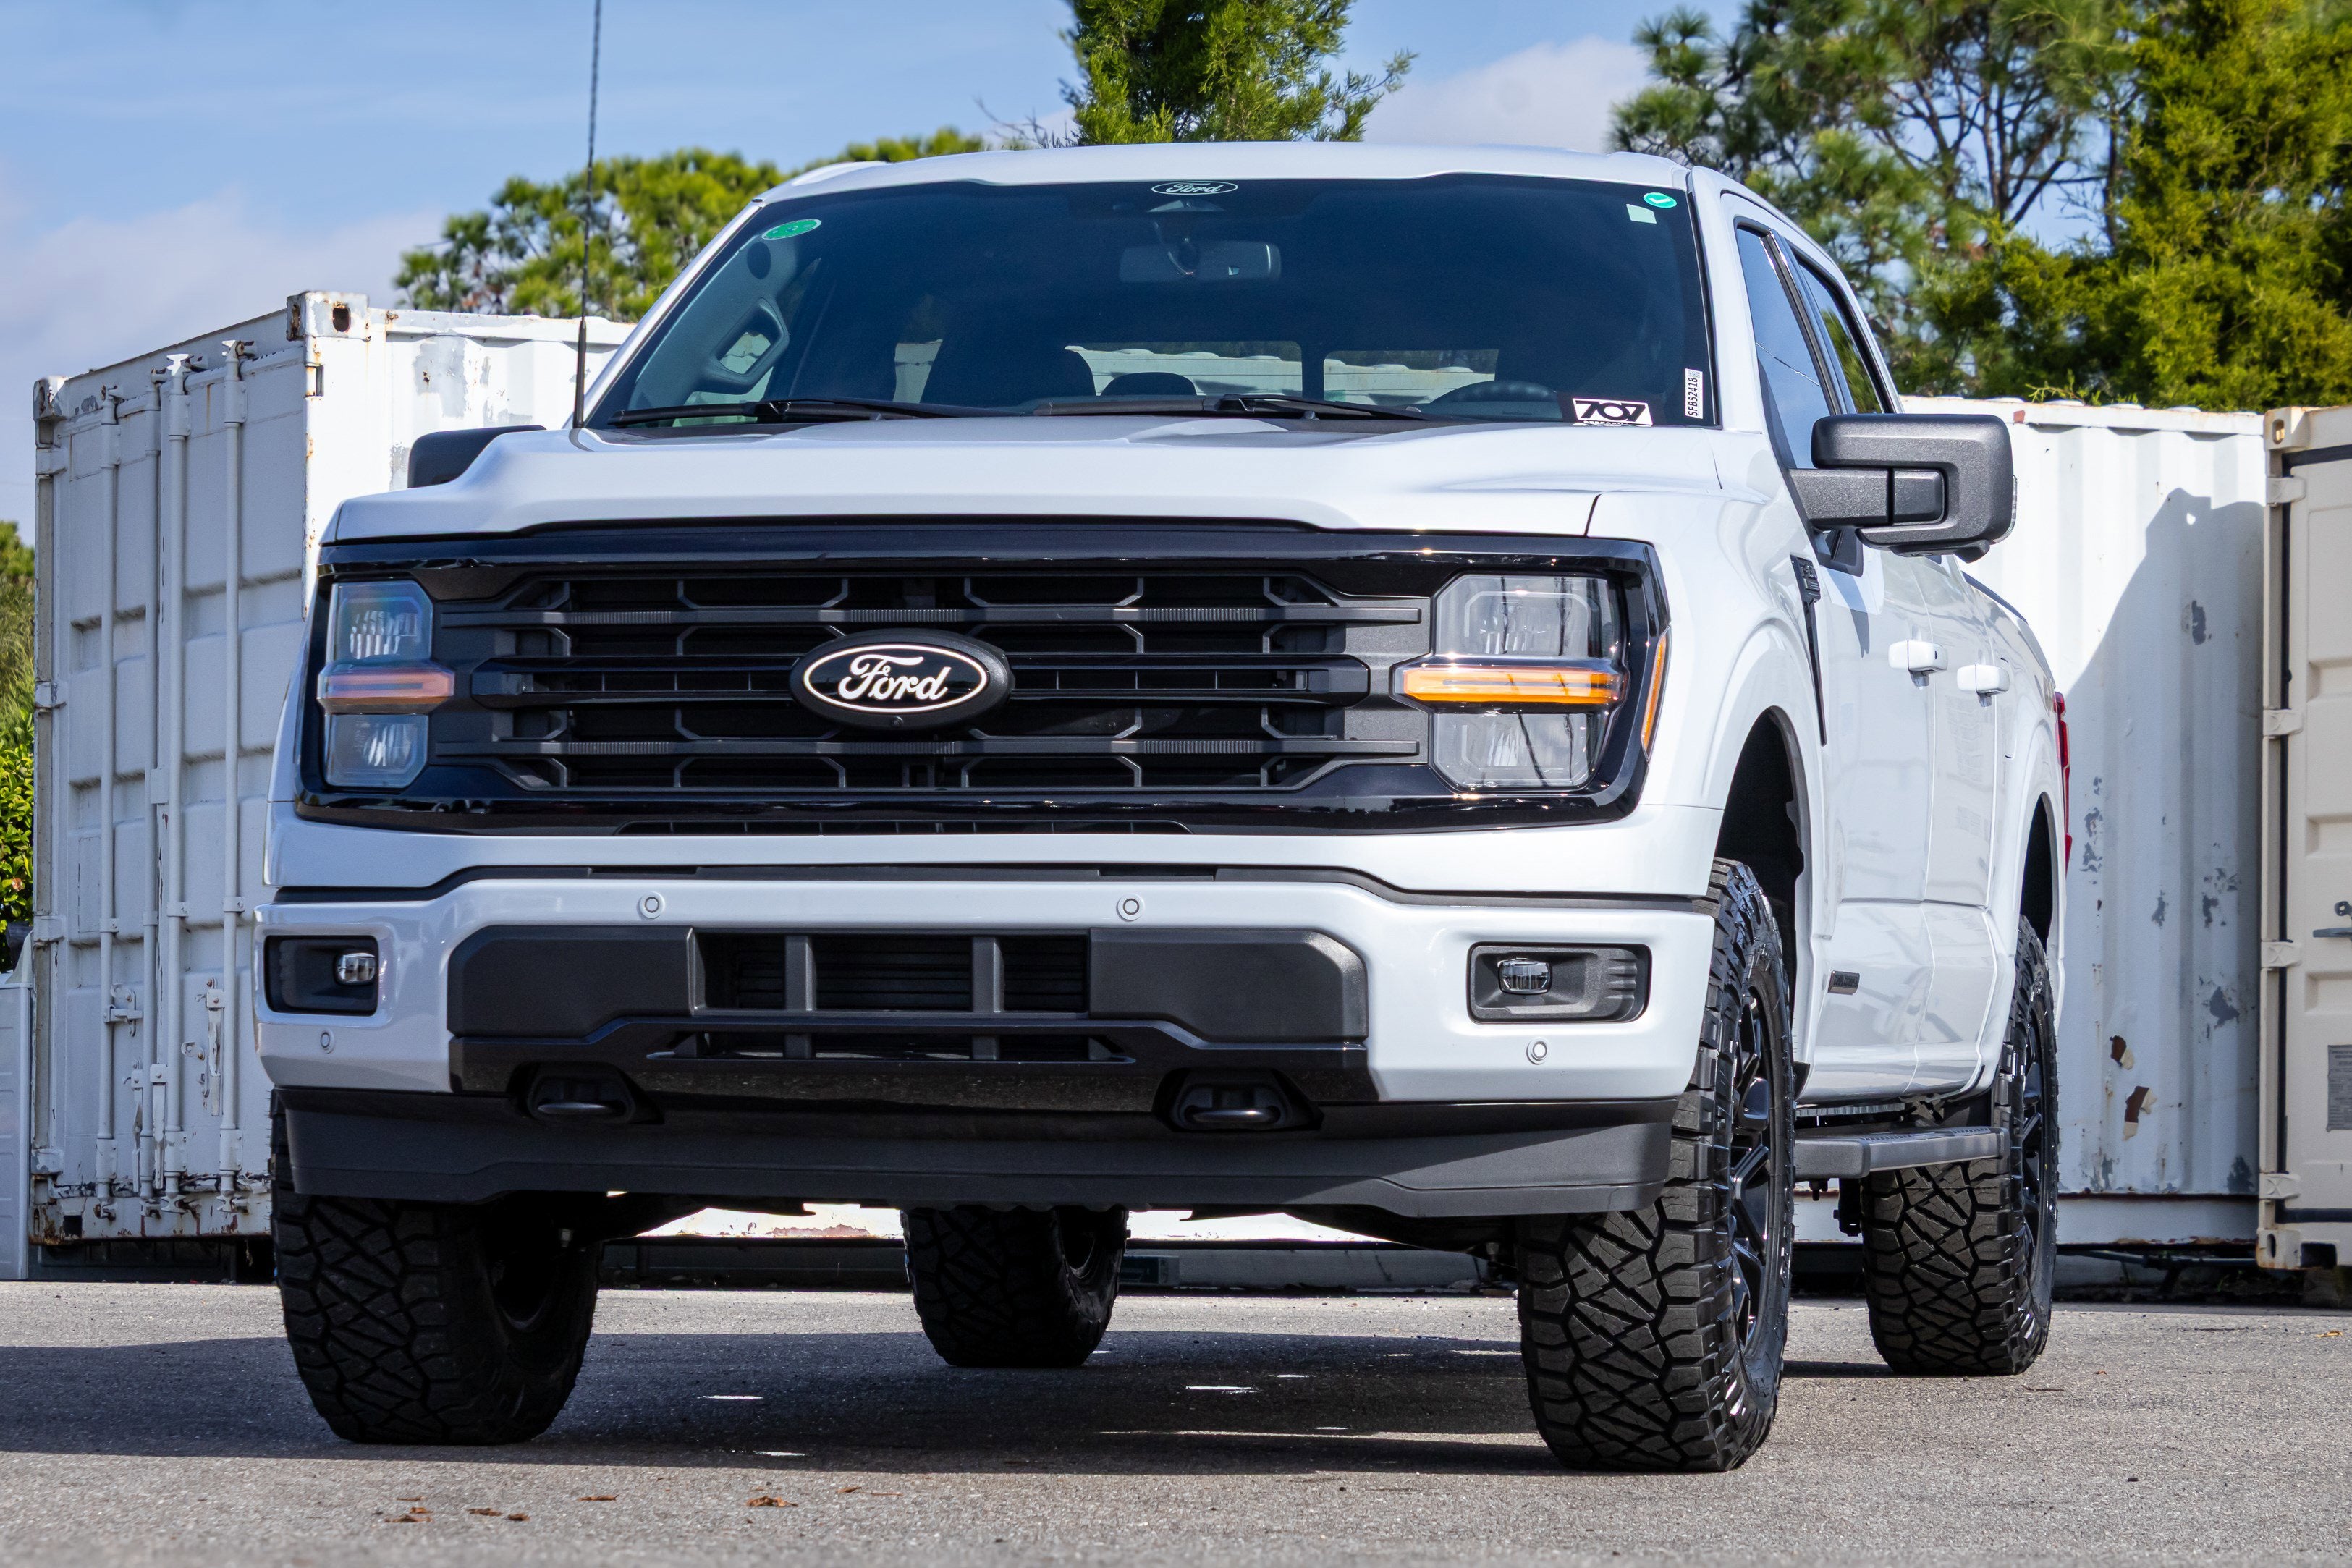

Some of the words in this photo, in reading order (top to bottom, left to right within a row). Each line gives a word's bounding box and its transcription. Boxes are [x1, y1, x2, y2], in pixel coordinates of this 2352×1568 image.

[1165, 182, 1224, 193] Ford
[1575, 399, 1646, 423] 707
[1688, 377, 1698, 417] SFB52418
[837, 653, 952, 700] Ford
